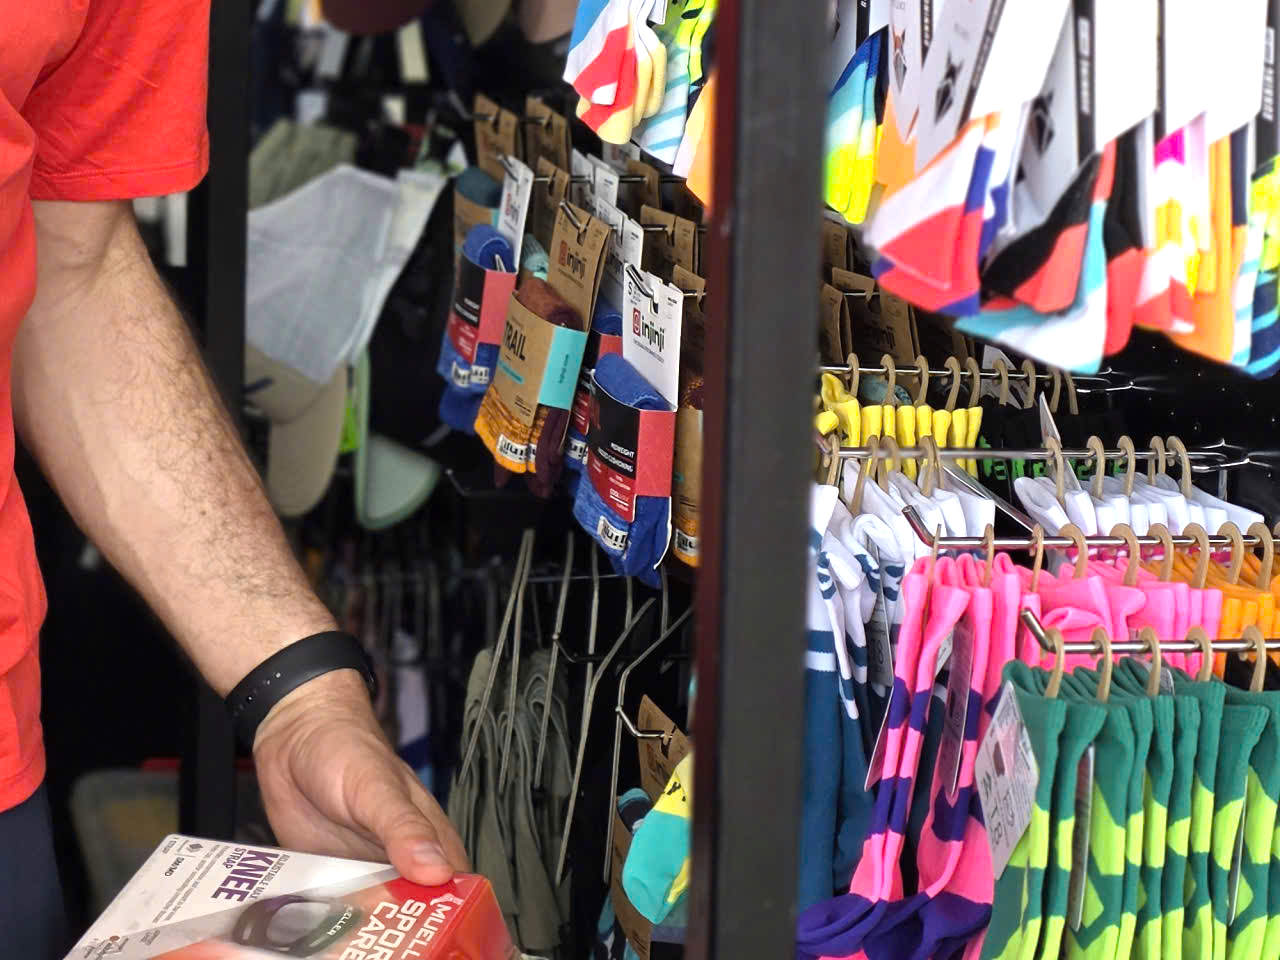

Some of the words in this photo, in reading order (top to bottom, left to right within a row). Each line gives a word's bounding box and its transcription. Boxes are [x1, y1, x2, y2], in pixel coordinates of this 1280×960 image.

[503, 319, 527, 362] TRAIL
[641, 315, 665, 353] injinji
[211, 849, 281, 903] KNEE
[224, 847, 247, 869] STRAP
[337, 901, 400, 960] CARE
